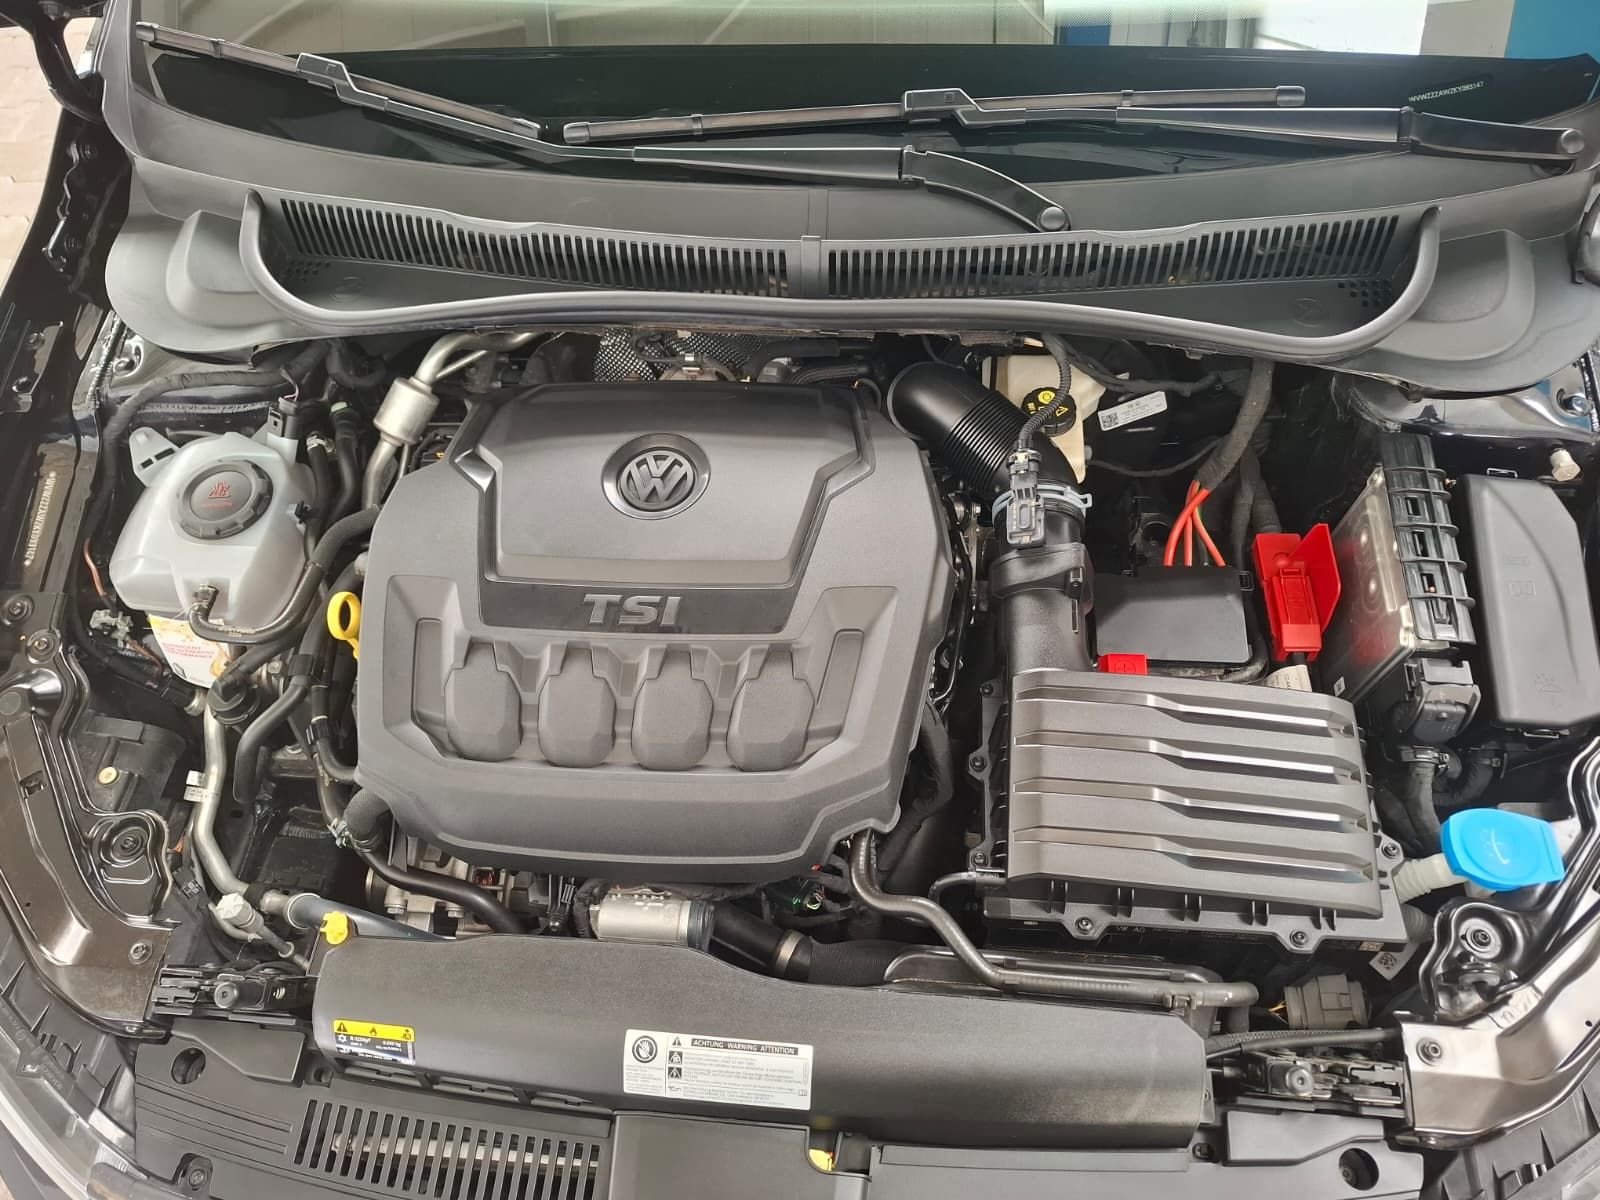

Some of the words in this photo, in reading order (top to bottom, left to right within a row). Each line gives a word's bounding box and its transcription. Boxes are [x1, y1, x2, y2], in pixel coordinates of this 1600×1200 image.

[583, 593, 683, 627] TSI
[693, 1040, 724, 1048] ACHTUNG
[727, 1042, 757, 1051] WARNING
[760, 1045, 795, 1055] ATTENTION
